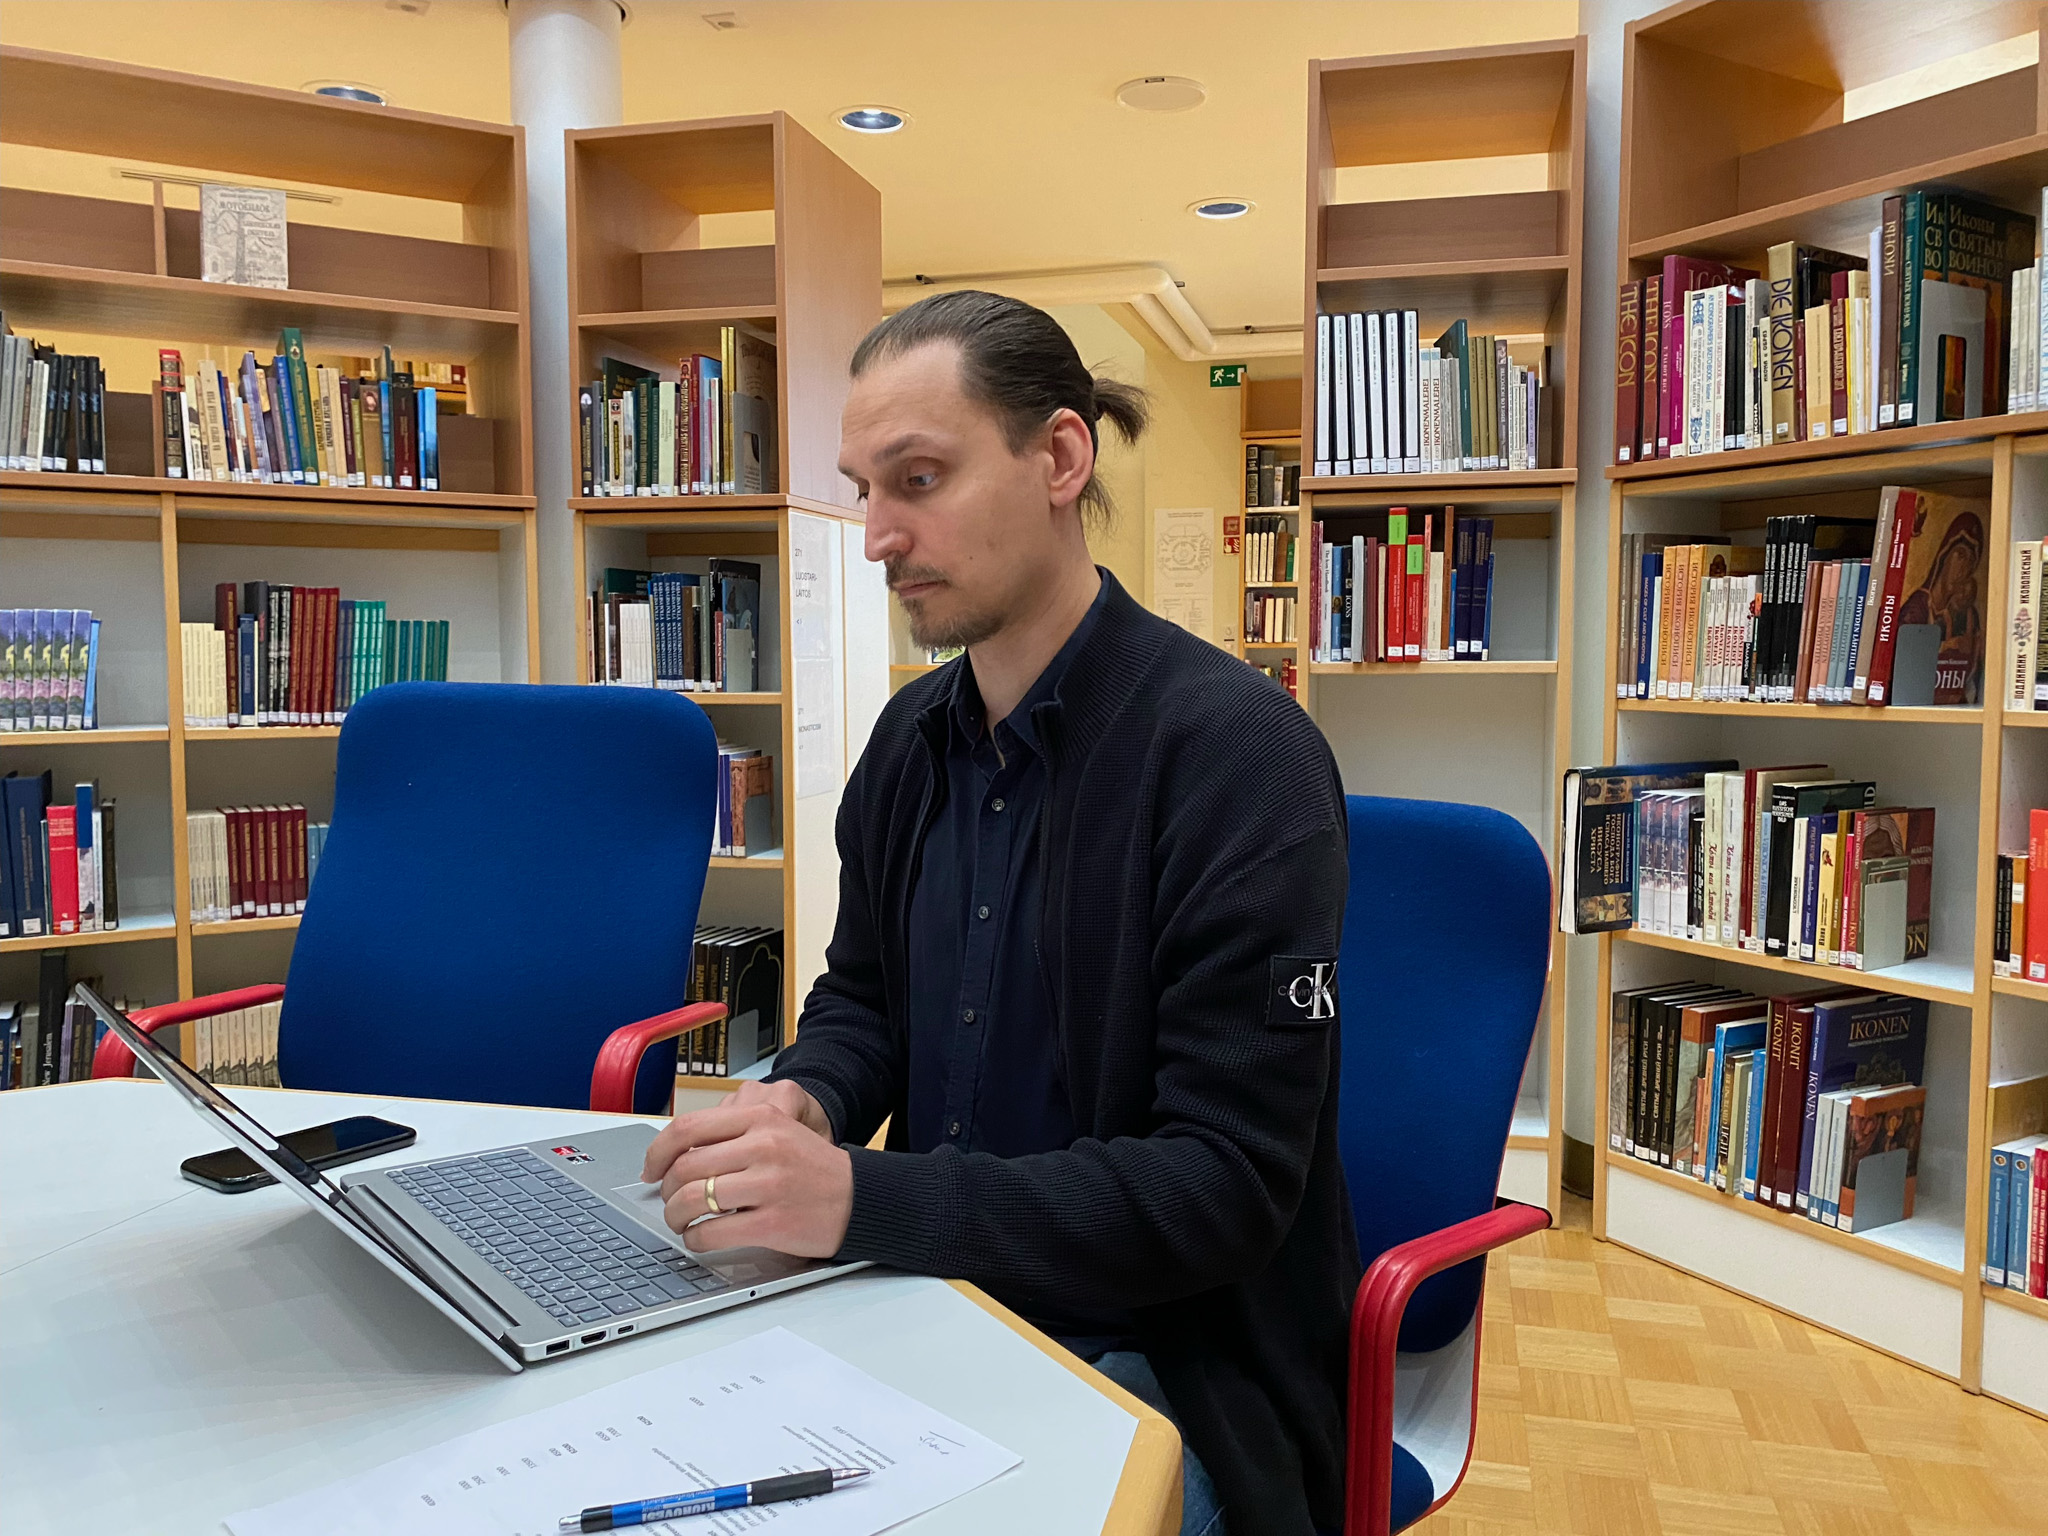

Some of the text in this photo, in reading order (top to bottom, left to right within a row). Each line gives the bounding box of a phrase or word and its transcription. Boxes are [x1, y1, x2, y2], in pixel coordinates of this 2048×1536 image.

[1950, 203, 1995, 229] Иконы
[1884, 220, 1896, 276] ИКОНЫ
[1950, 227, 2005, 258] СВЯТЫХ
[1949, 251, 2004, 278] ВОИНОВ
[1644, 281, 1659, 382] THE ICON
[1662, 300, 1672, 329] ICONS
[1618, 286, 1638, 388] THE ICON
[1771, 279, 1794, 392] DIE IKONEN
[795, 572, 818, 581] LUOSTARI-
[796, 589, 811, 598] LAITOS
[1867, 579, 1877, 606] Ikonen
[1661, 563, 1672, 665] ИСТОРИЯ ИКОНОПИСИ
[1672, 565, 1684, 667] ИСТОРИЯ ИКОНОПИСИ
[1685, 563, 1698, 666] ИСТОРИЯ ИКОНОПИСИ
[1848, 596, 1863, 670] PYHYYDEN LÄHTEILLÄ
[1880, 596, 1895, 642] ИКОНЫ
[2014, 654, 2027, 699] ПОДЛИННИК
[1854, 843, 1862, 869] LÖNNEBO
[1848, 922, 1857, 948] IKON
[1907, 932, 1927, 953] ON
[1772, 1013, 1784, 1062] IKONIT
[1789, 1021, 1803, 1070] IKONIT
[1850, 1014, 1911, 1041] IKONEN
[42, 1033, 52, 1068] Jerusalem
[1666, 1047, 1675, 1065] РУСИ
[1639, 1040, 1650, 1116] СВЯТЫЕ ДРЕВНЕЙ РУСИ
[1652, 1043, 1663, 1118] СВЯТЫЕ ДРЕВНЕЙ РУСИ
[1805, 1071, 1818, 1121] IKONEN
[1720, 1126, 1730, 1156] LIGHT
[642, 1501, 716, 1522] KIURUVESI
